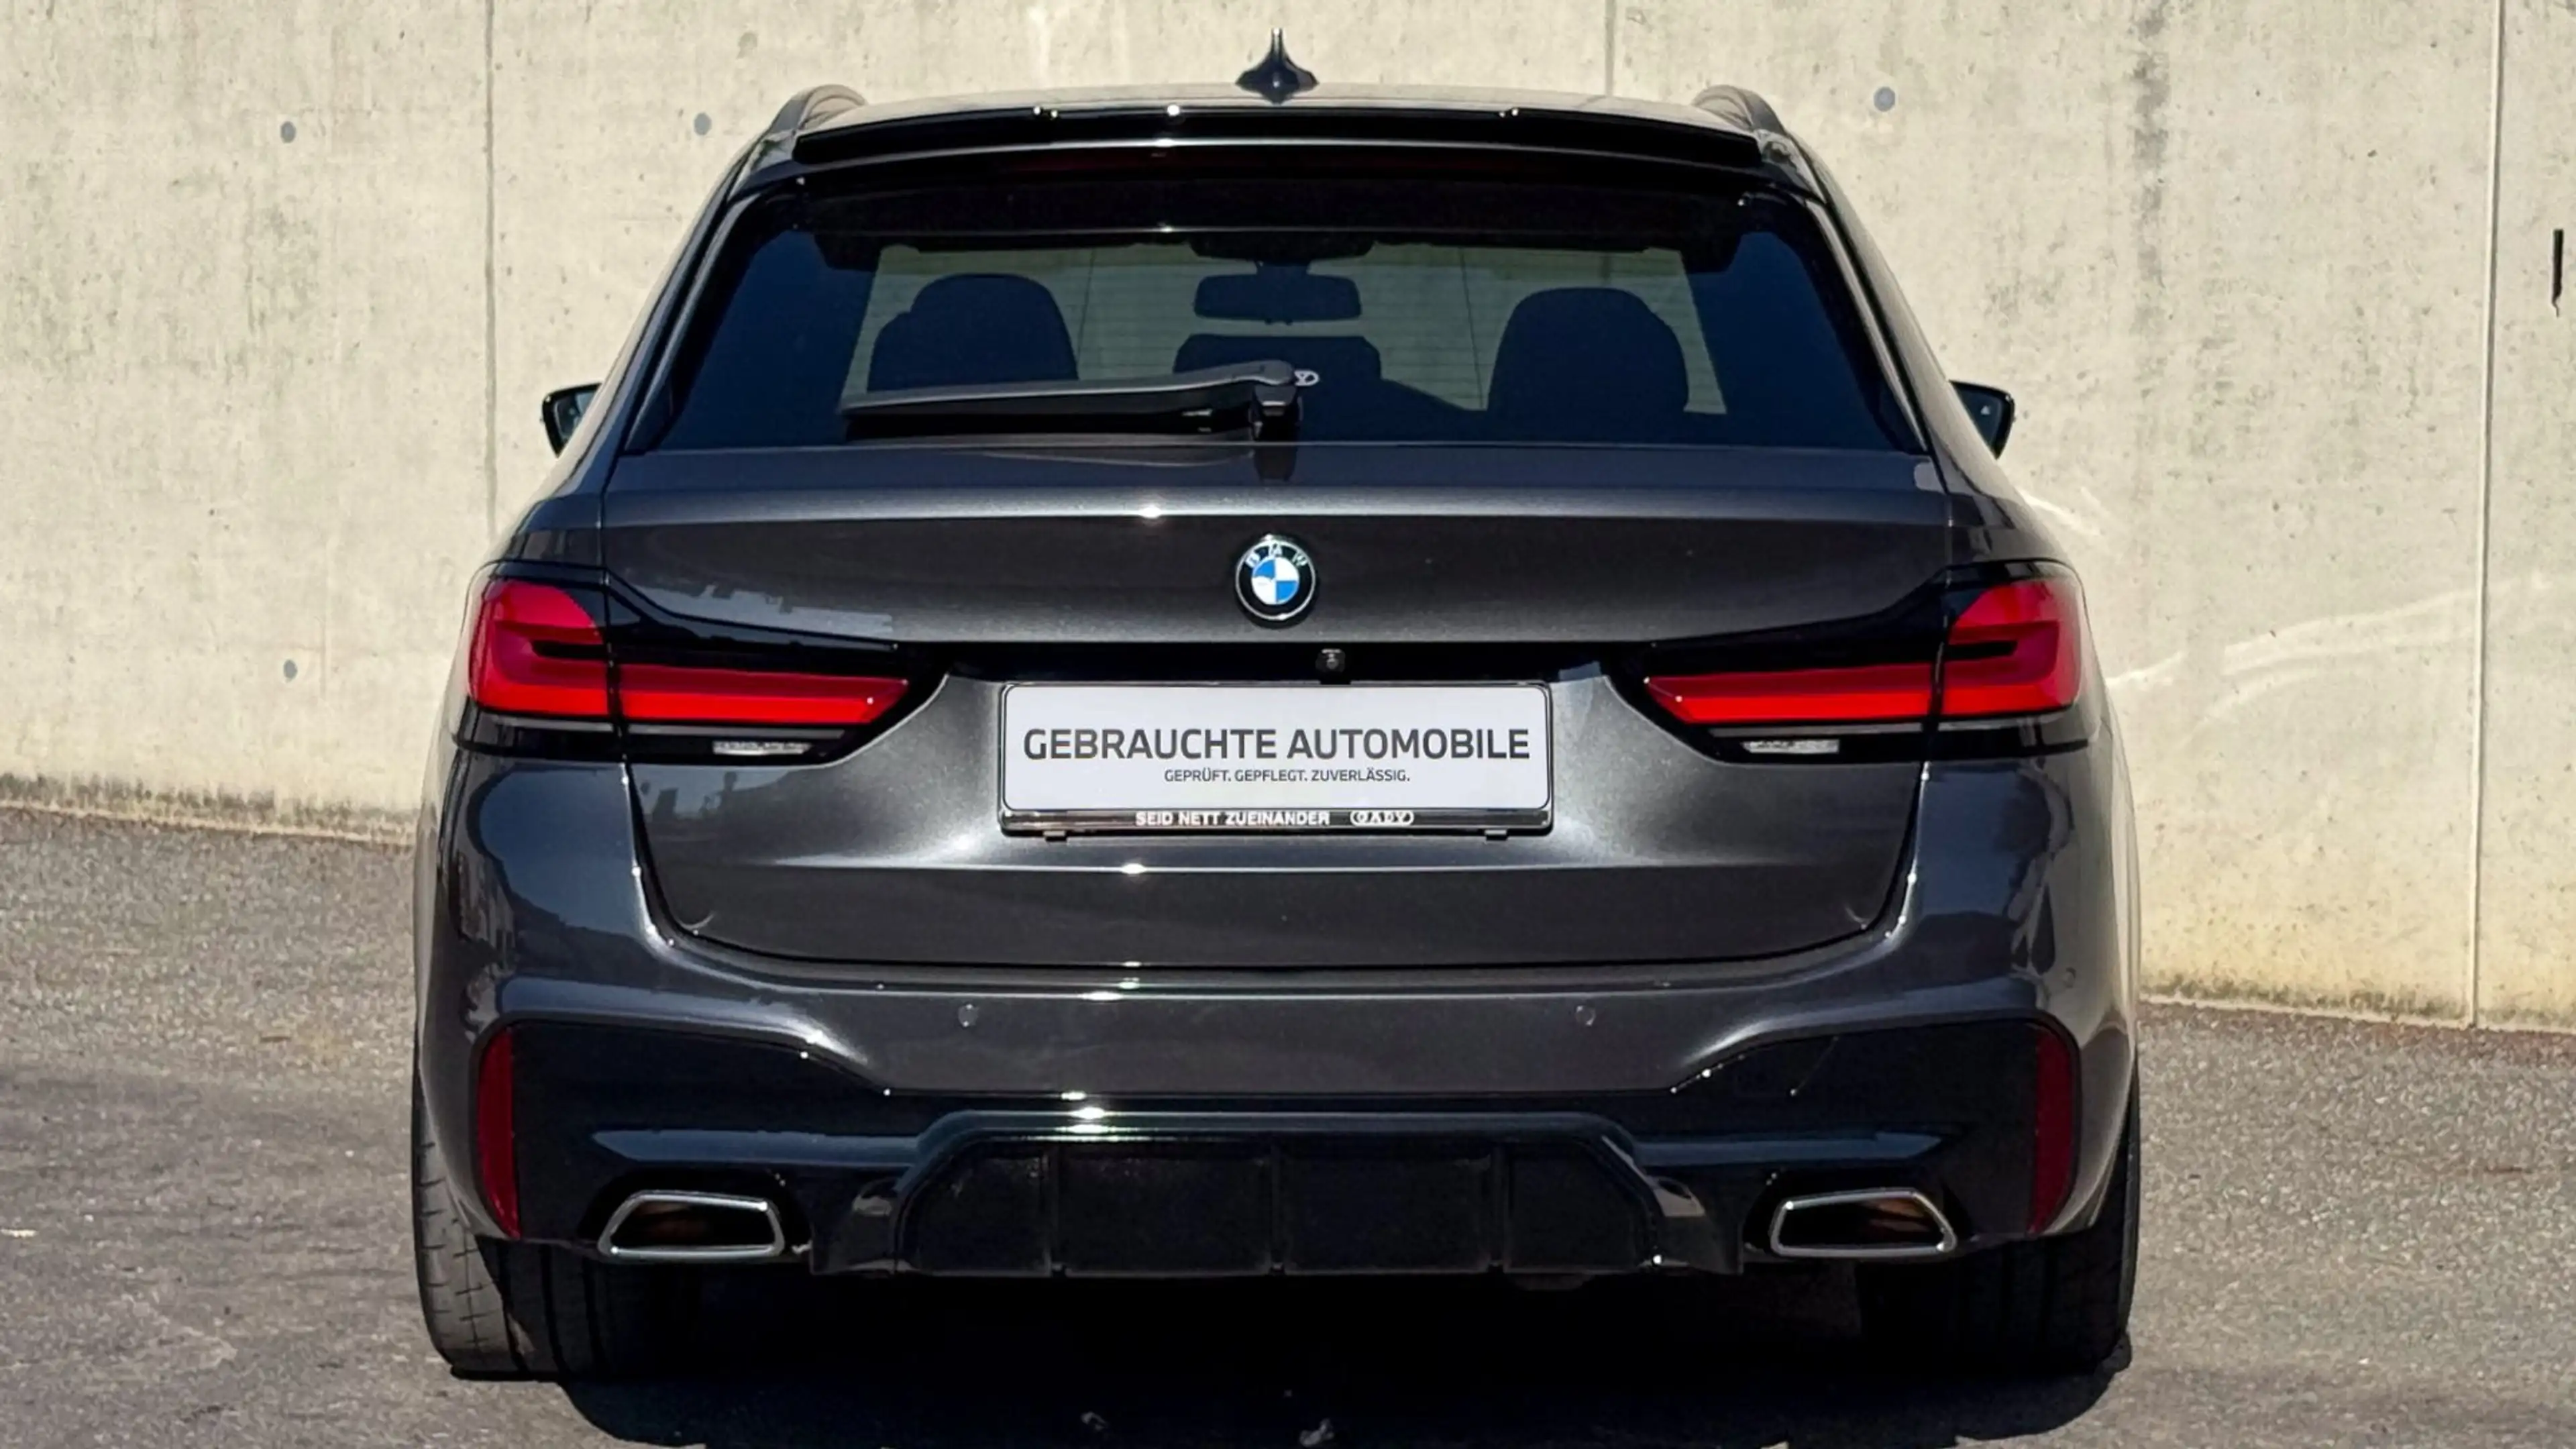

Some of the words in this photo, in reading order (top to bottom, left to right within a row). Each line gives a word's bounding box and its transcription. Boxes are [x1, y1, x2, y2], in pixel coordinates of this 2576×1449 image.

[1245, 543, 1309, 568] BMW
[1023, 729, 1277, 759] GEBRAUCHTE
[1287, 729, 1530, 759] AUTOMOBILE
[1164, 767, 1232, 782] GEPRÜFT.
[1234, 769, 1307, 782] GEPFLEGT.
[1311, 767, 1411, 782] ZUVERLÄSSIG.
[1135, 810, 1173, 826] SEID
[1178, 810, 1219, 826] NETT
[1225, 810, 1330, 826] ZUEINANDER
